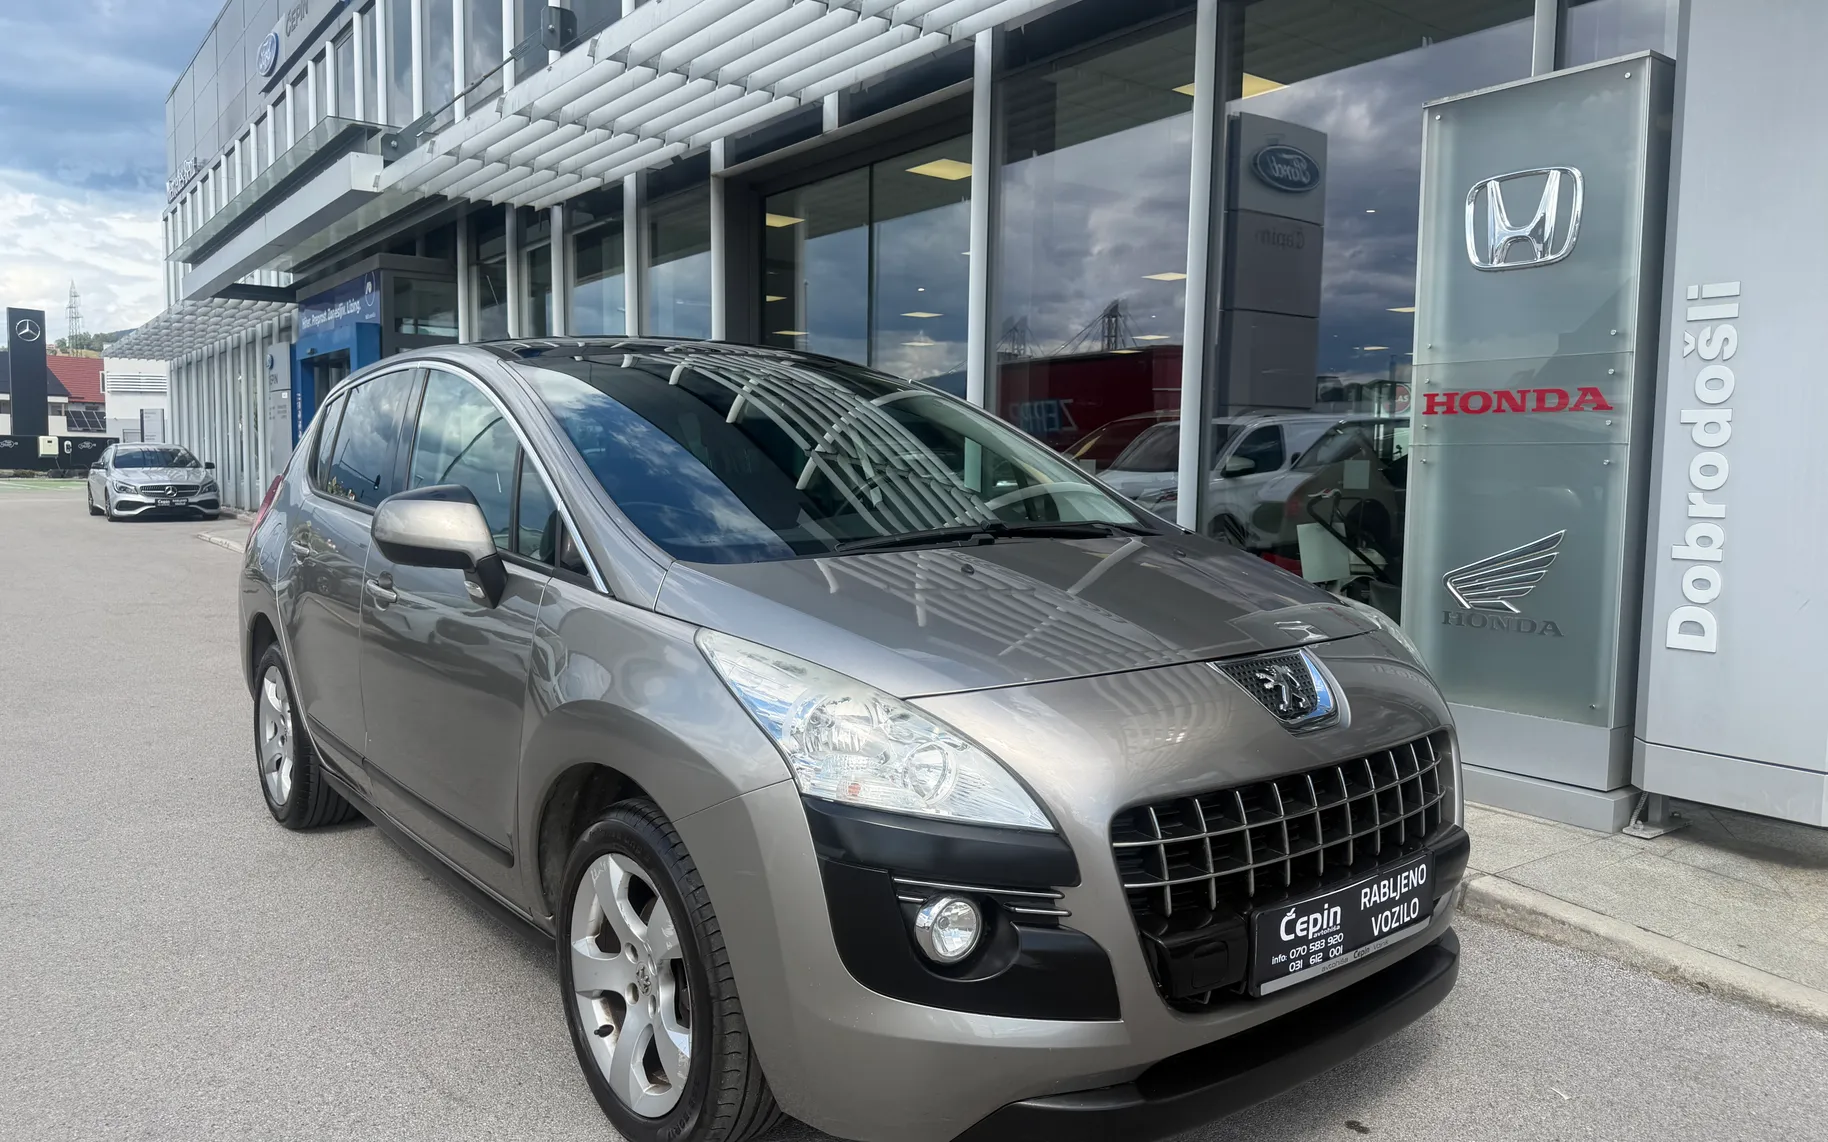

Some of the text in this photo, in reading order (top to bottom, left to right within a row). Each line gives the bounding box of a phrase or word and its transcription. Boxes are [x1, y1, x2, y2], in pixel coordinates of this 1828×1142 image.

[1421, 386, 1613, 415] HONDA
[1665, 281, 1741, 653] Dobrodošli
[1441, 610, 1564, 637] HONDA
[1360, 863, 1427, 911] RABLJENO
[1279, 903, 1342, 942] Čepin
[1371, 897, 1420, 937] VOZILO
[1271, 932, 1344, 965] info: 070 583 920
[1288, 944, 1343, 972] 031 612 001
